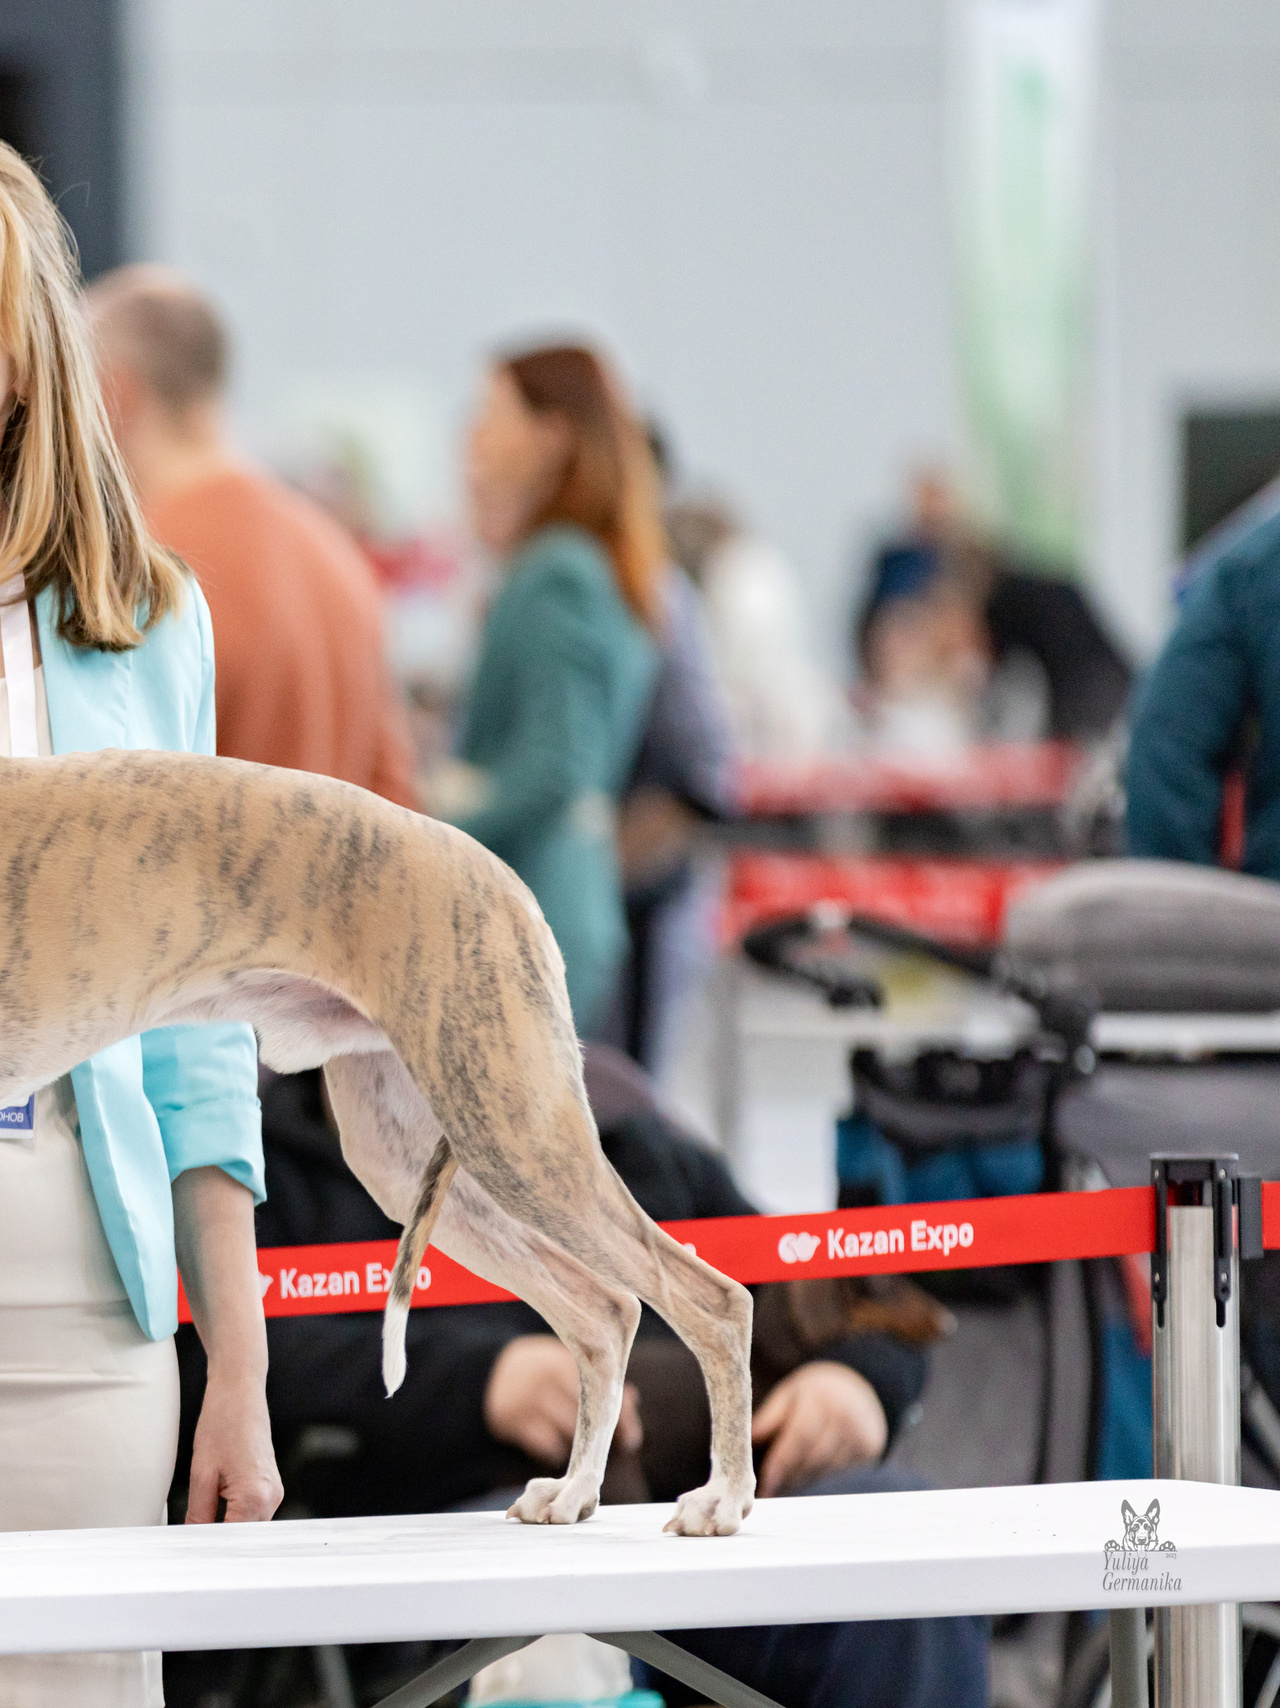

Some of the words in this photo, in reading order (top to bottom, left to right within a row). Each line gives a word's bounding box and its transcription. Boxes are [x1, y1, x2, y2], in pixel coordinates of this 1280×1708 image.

[827, 1228, 905, 1259] Kazan
[910, 1220, 974, 1256] Expo
[279, 1268, 360, 1299] Kazan
[365, 1262, 432, 1293] Exo
